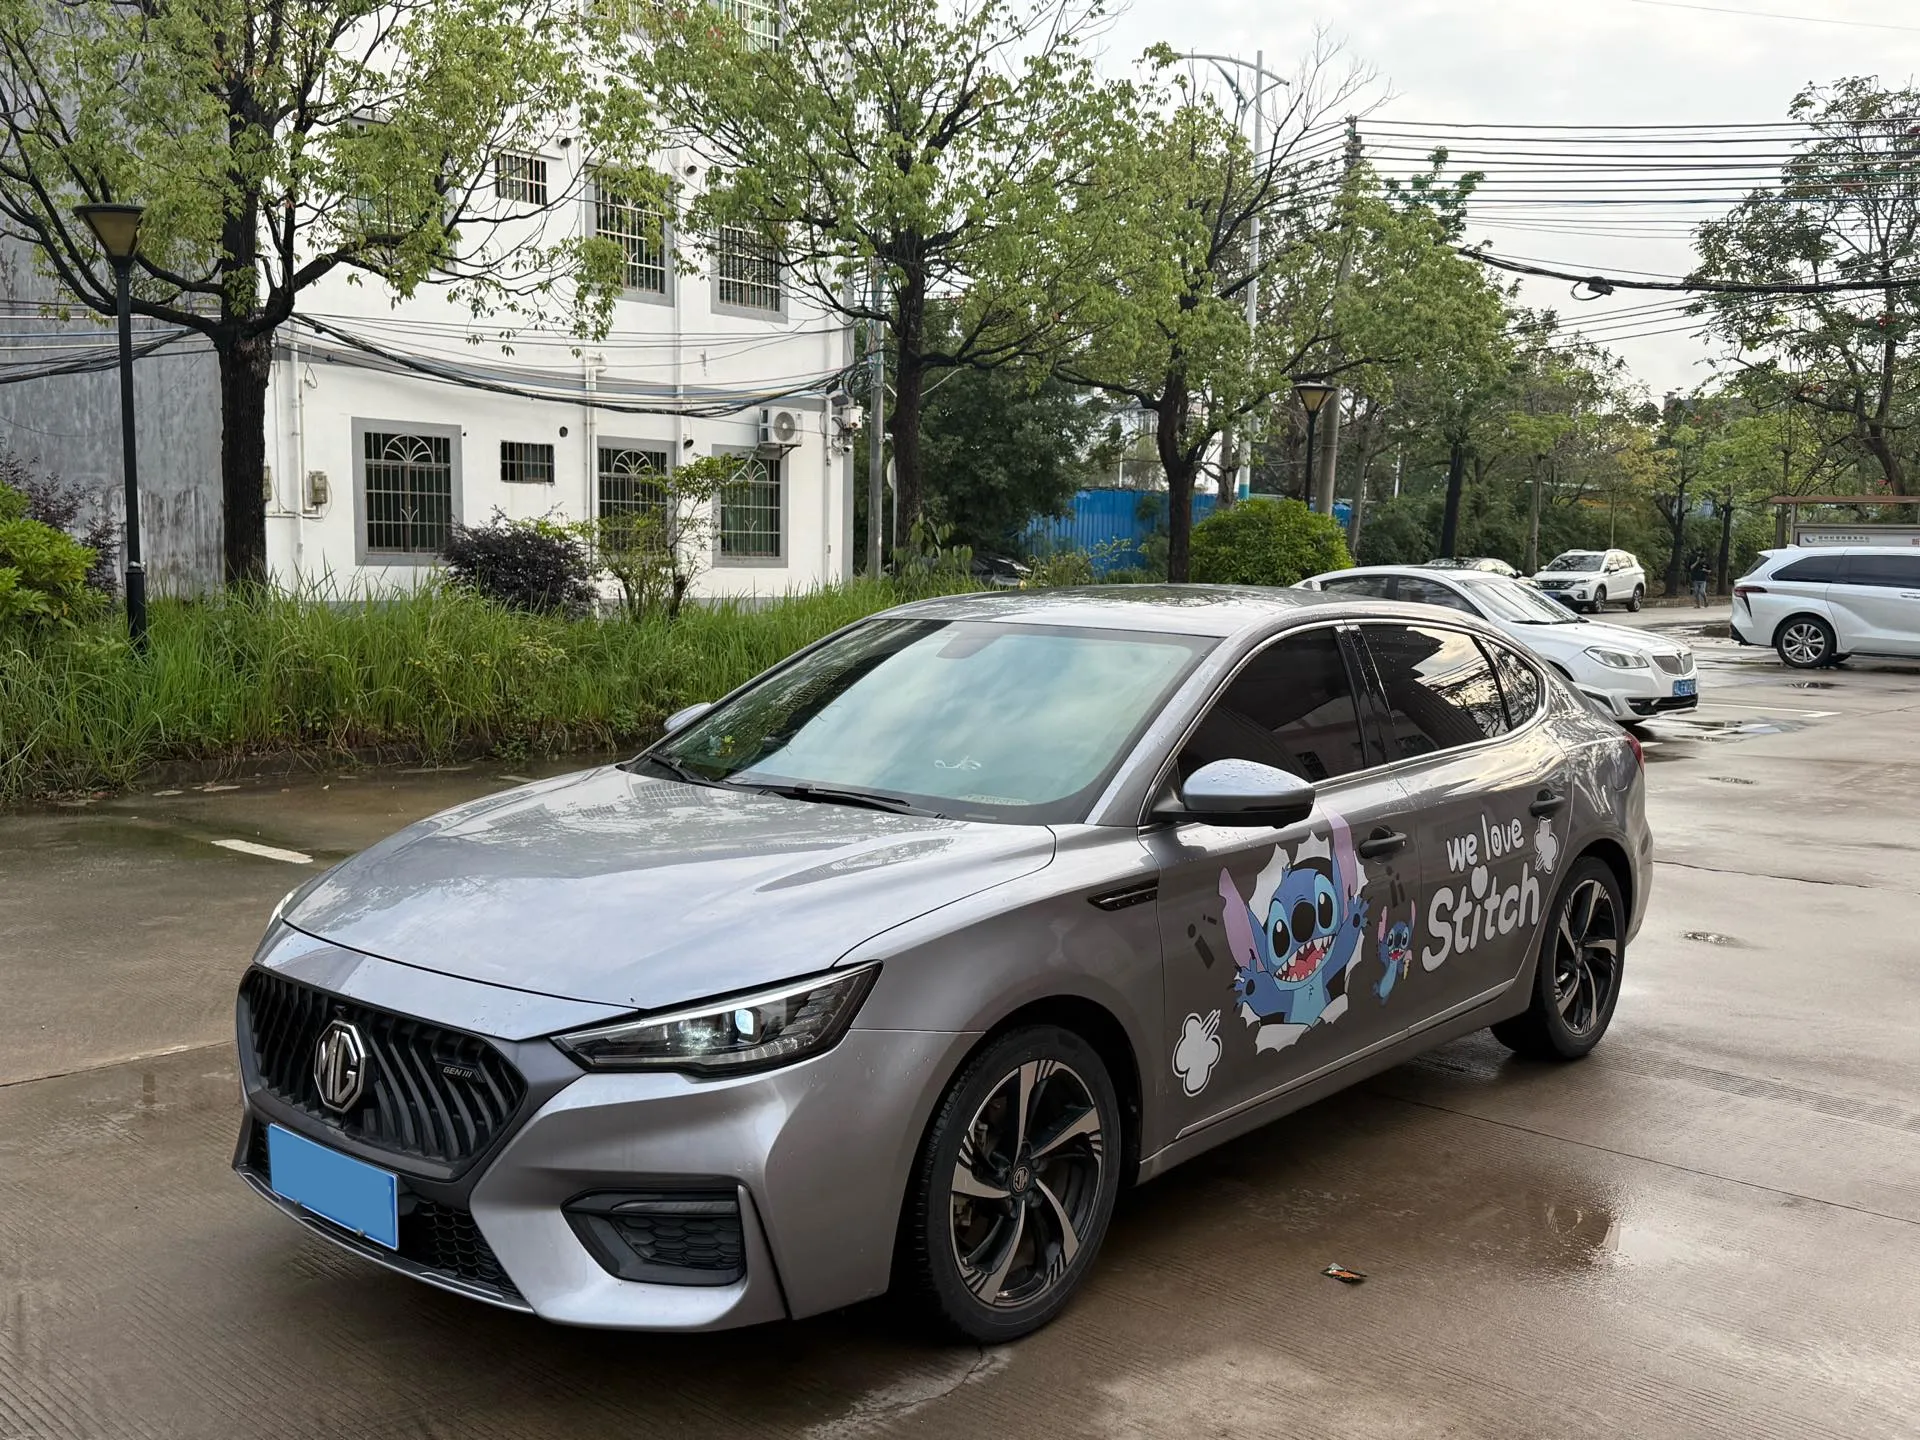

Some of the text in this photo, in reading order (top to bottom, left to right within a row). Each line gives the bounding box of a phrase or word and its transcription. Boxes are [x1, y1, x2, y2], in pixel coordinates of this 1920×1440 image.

[1446, 814, 1524, 872] we love
[1421, 861, 1540, 972] Stitch
[319, 1030, 359, 1101] MG
[443, 1066, 462, 1077] GEN
